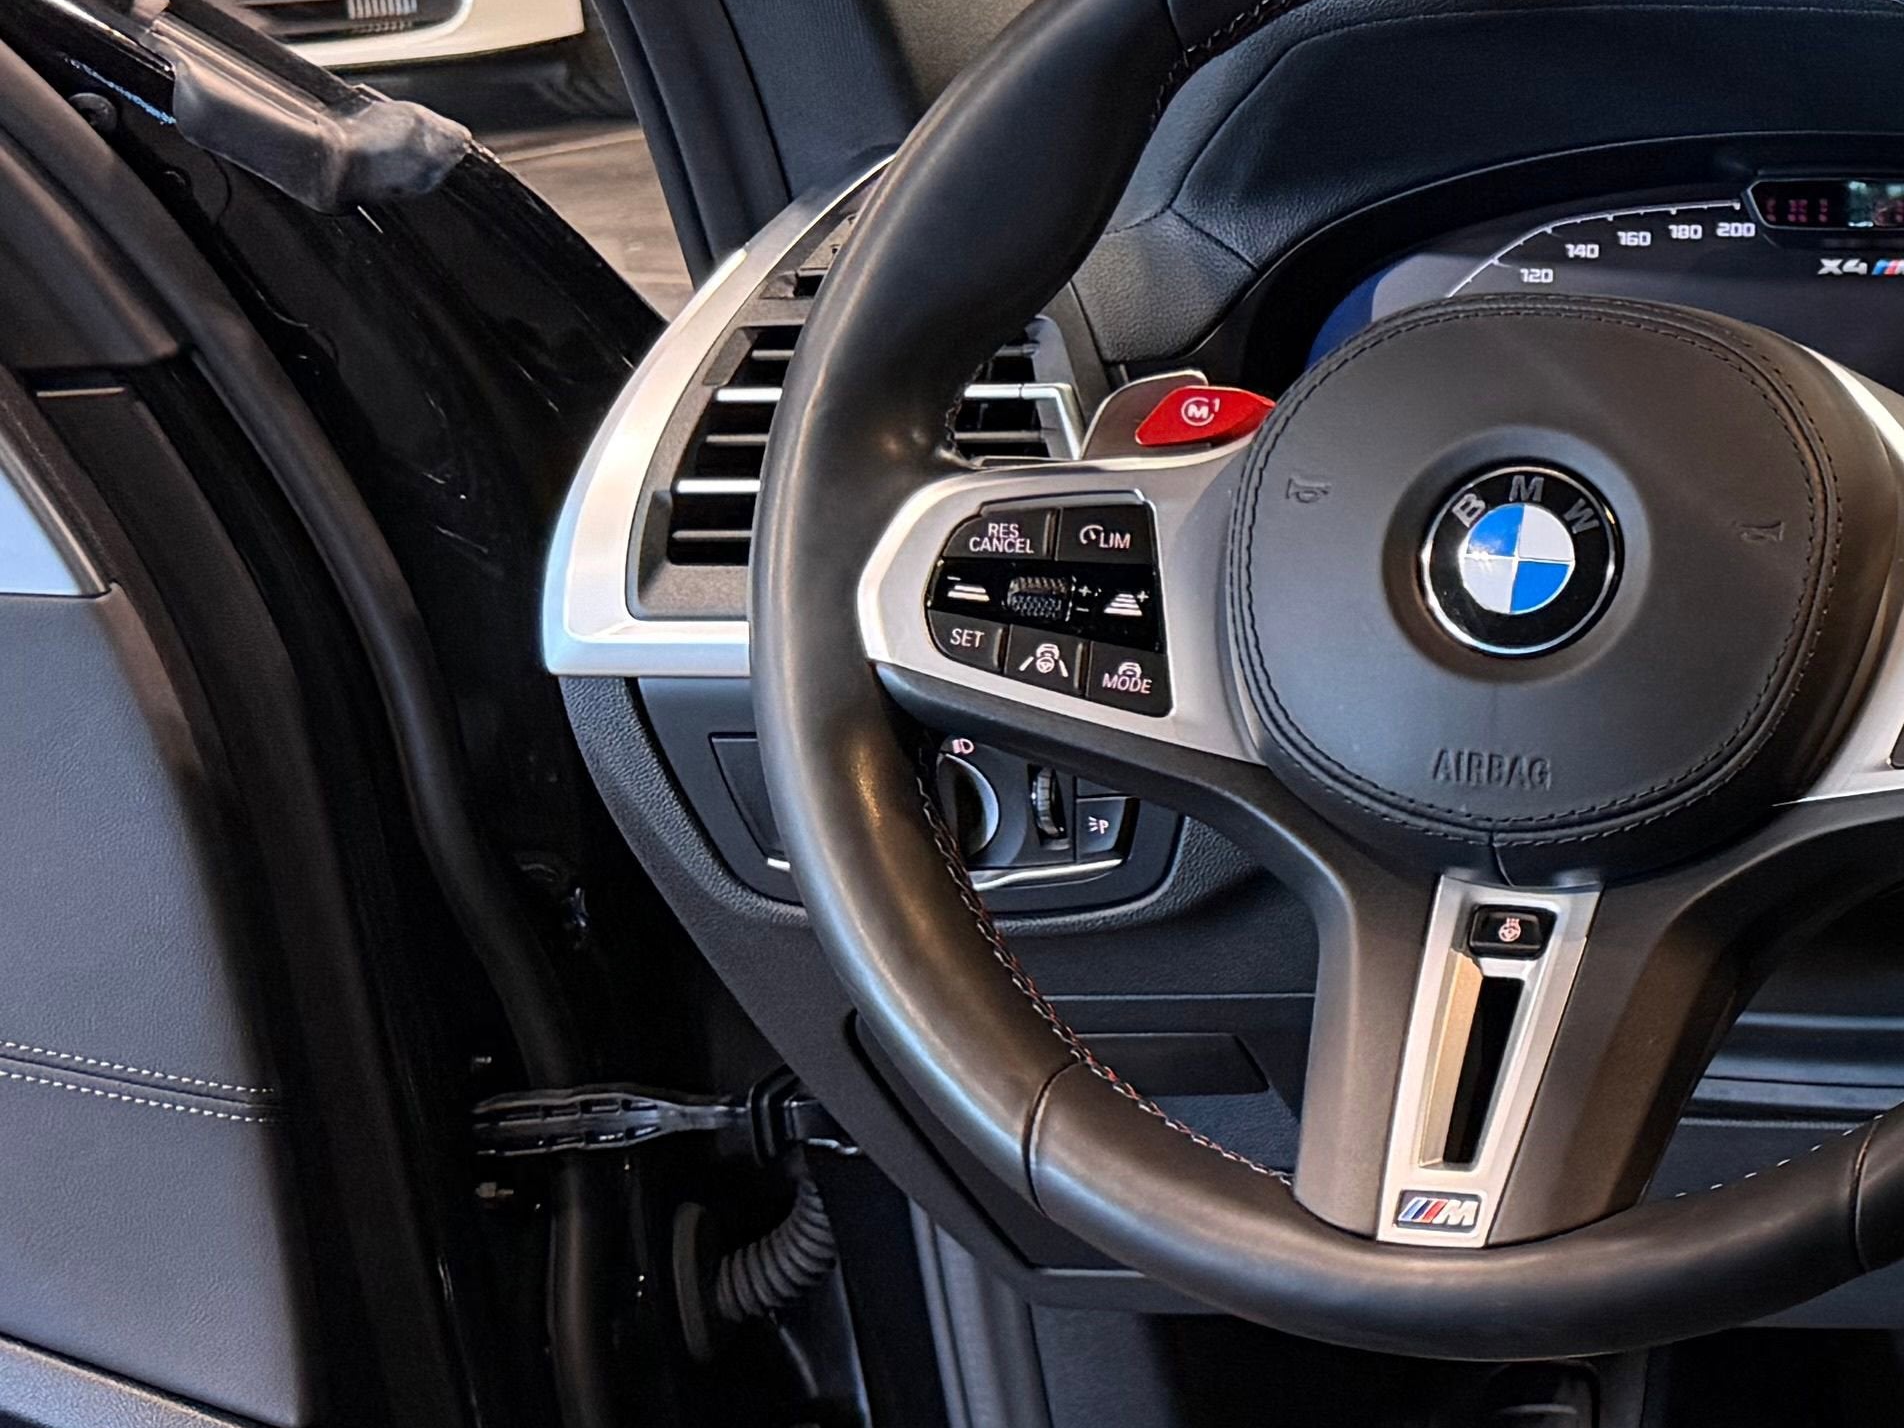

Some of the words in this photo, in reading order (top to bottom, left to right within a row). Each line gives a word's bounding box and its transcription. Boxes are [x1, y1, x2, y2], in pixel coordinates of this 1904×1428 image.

[1520, 268, 1553, 284] 120
[1565, 243, 1599, 259] 140
[1617, 231, 1651, 246] 160
[1669, 225, 1702, 240] 180
[1716, 223, 1756, 238] 200
[1818, 258, 1867, 275] X4
[1453, 475, 1600, 534] BMW
[988, 523, 1019, 539] RES
[1100, 532, 1131, 549] LIM
[969, 537, 1034, 554] CANCEL
[951, 629, 985, 648] SET
[1102, 673, 1153, 694] MODE
[1433, 748, 1551, 790] AIRBAG
